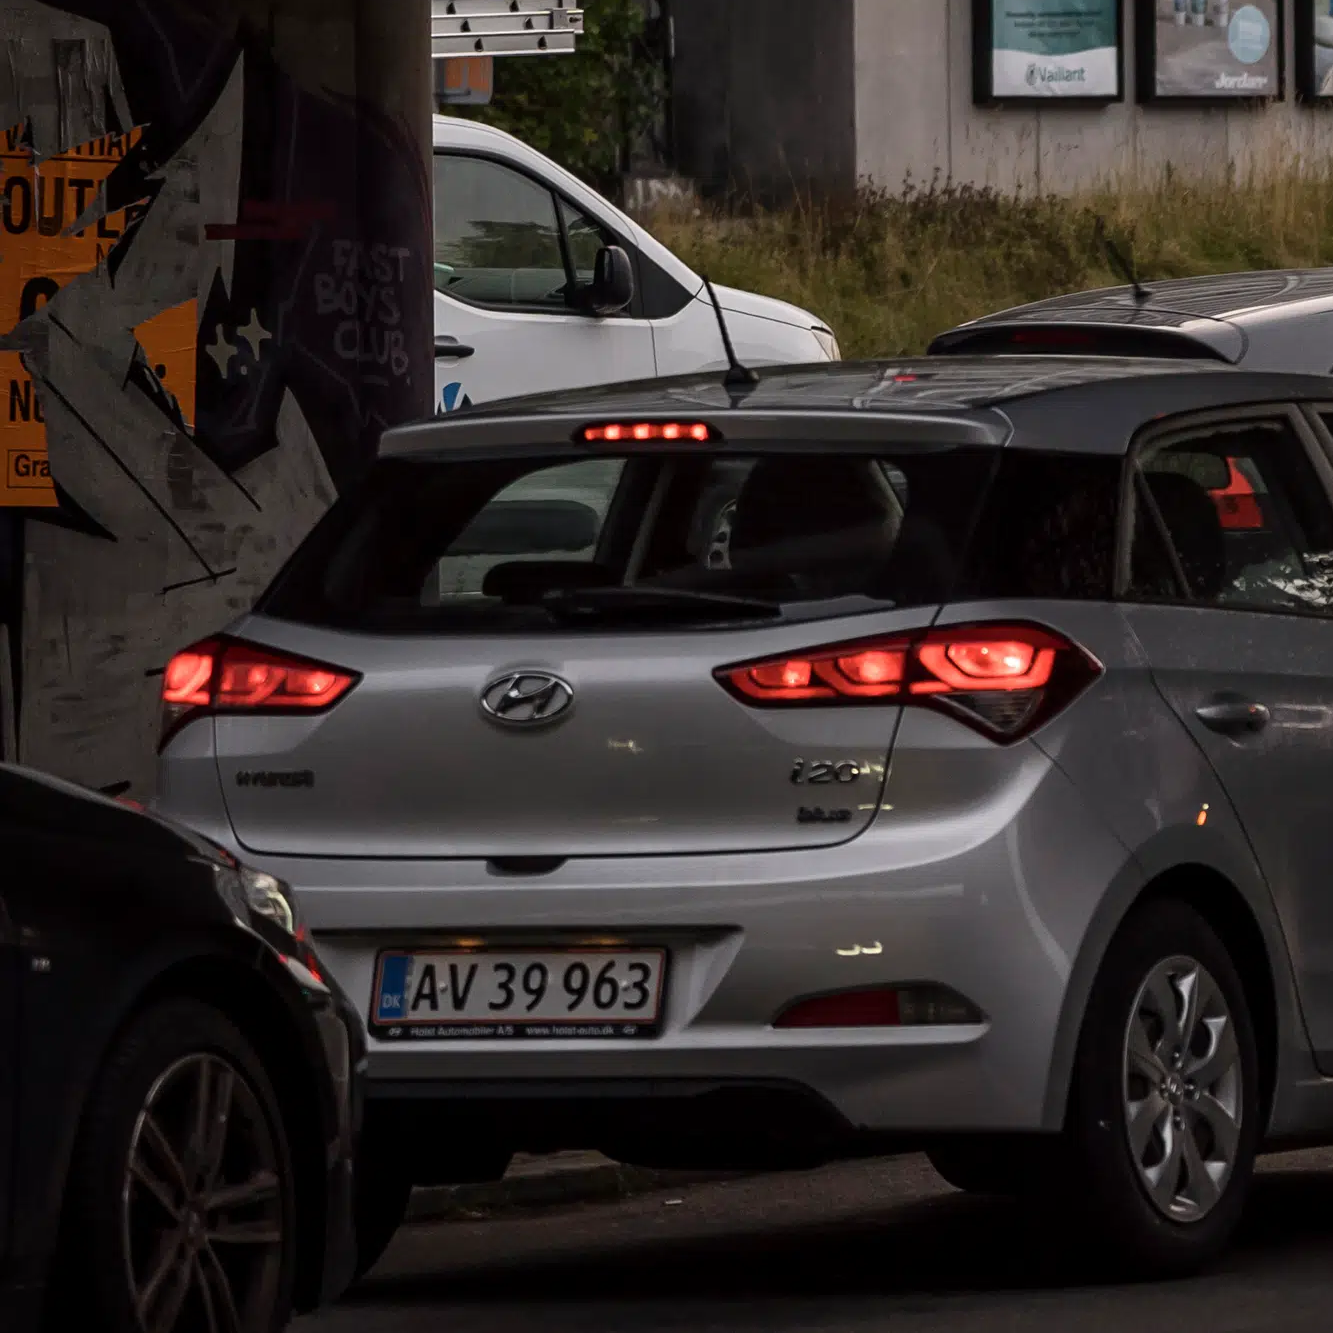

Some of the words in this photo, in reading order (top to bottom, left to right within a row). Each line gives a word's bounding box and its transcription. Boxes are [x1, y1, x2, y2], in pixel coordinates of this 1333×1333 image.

[1040, 67, 1086, 82] Vaillant
[332, 239, 411, 283] FAST
[314, 272, 401, 326] BOYS
[791, 756, 859, 784] i20
[382, 993, 401, 1010] DK
[411, 964, 478, 1012] AV
[489, 962, 549, 1012] 39
[563, 960, 652, 1012] 963
